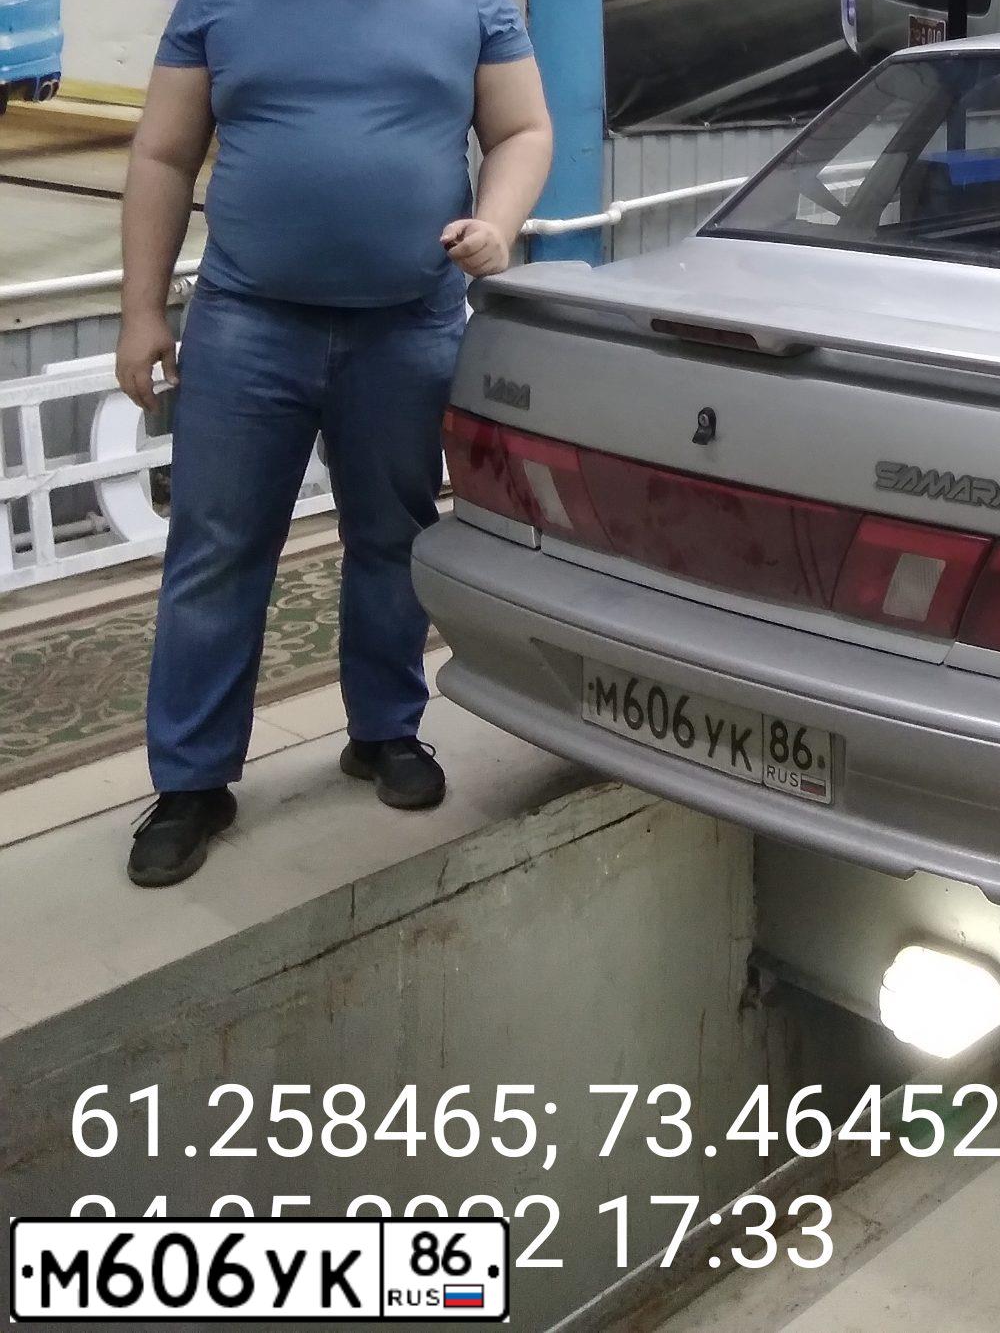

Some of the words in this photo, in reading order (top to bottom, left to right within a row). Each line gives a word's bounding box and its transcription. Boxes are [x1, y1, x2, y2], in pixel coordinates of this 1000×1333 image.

[595, 676, 752, 773] М606УК
[769, 719, 813, 771] 86
[766, 764, 800, 788] RUS
